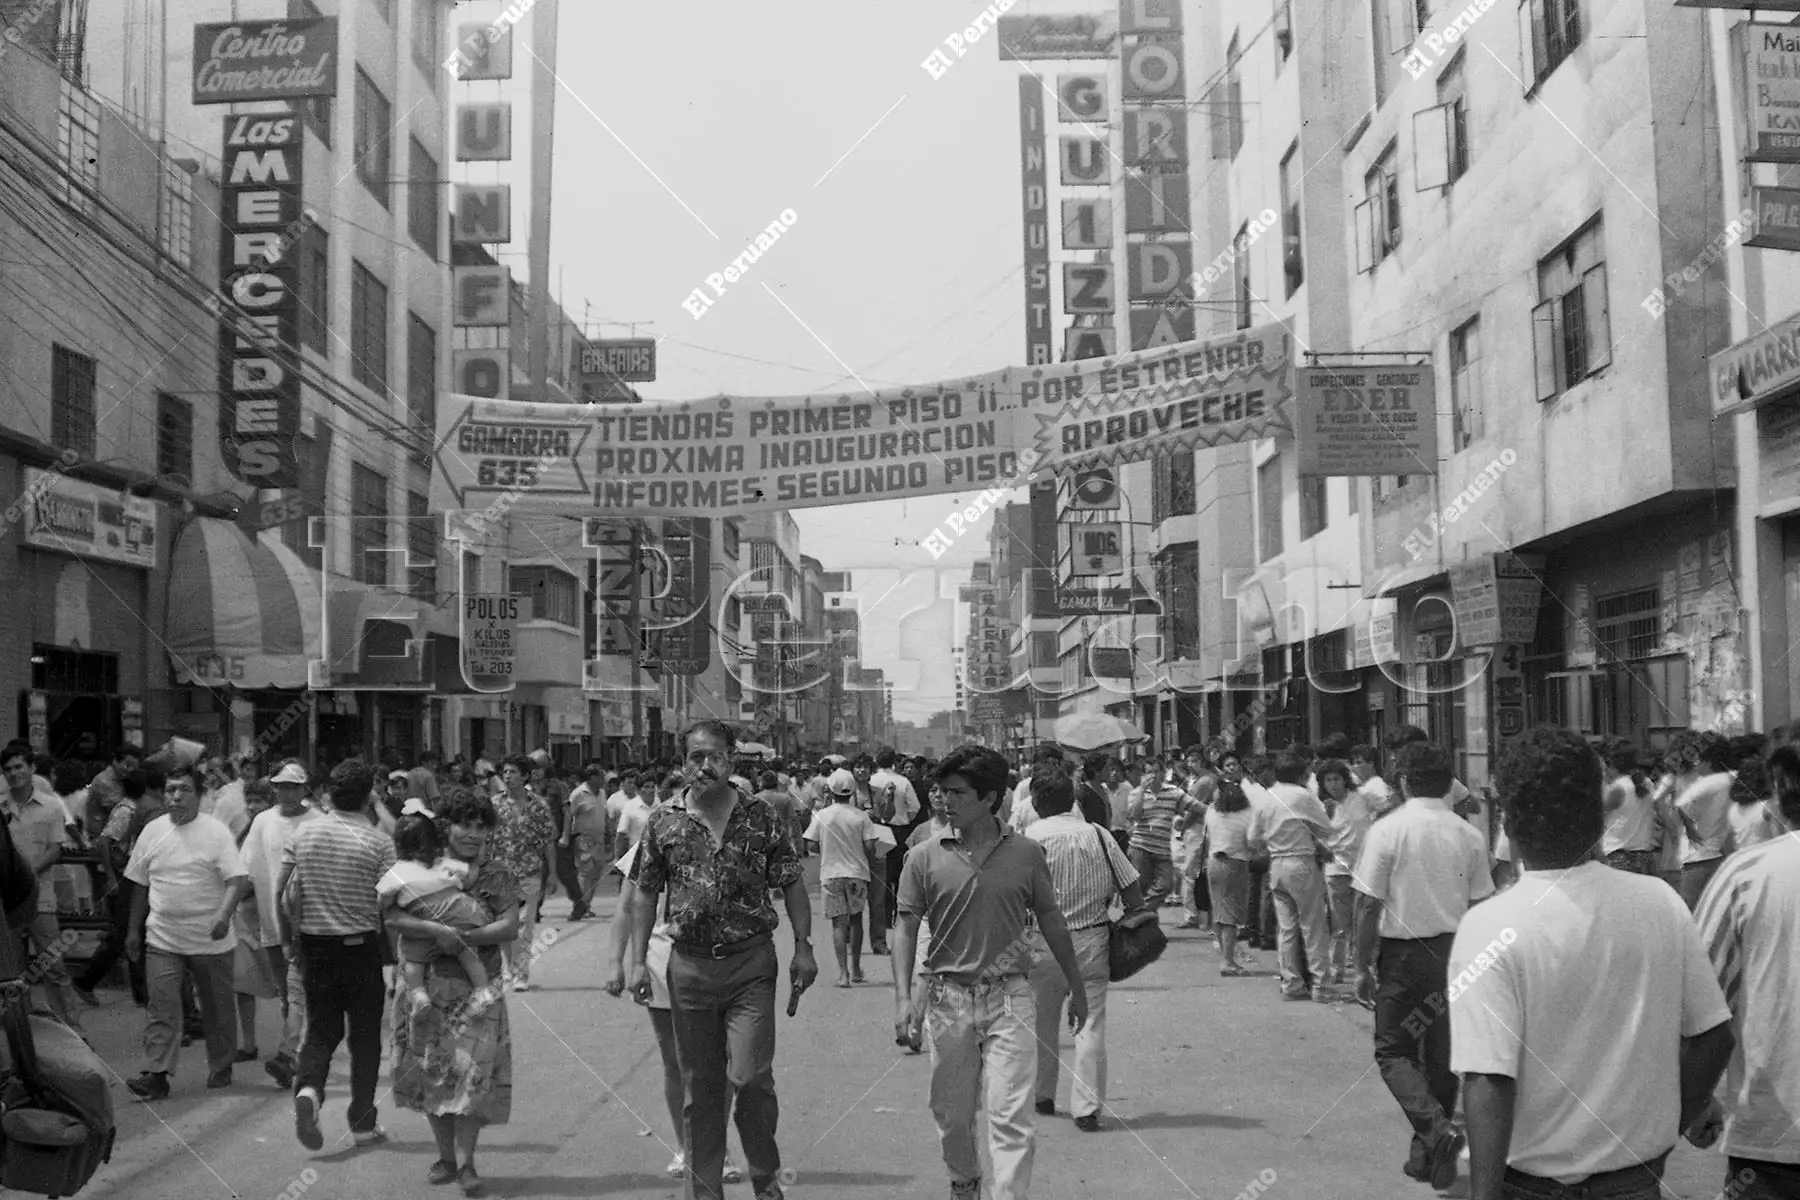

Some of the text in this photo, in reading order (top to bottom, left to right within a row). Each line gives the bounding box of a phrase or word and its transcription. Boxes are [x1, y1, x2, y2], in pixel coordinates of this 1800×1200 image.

[211, 27, 305, 59] Centro
[196, 54, 326, 91] Comercial
[228, 117, 294, 145] Las
[229, 148, 290, 475] MERCEDES
[581, 347, 650, 373] GALERIAS
[597, 411, 734, 442] TIENDAS
[750, 403, 872, 438] PRIMER
[888, 393, 961, 426] PISO
[1061, 389, 1264, 455] APROVECHE
[457, 425, 570, 458] GAMARRA
[595, 420, 996, 475] PROXIMA INAUGURACION
[477, 458, 539, 486] 635
[776, 461, 928, 500] SEGUNDO
[944, 452, 1018, 486] PISO
[467, 598, 518, 620] POLOS
[473, 628, 511, 640] KILOS
[489, 661, 513, 674] 203
